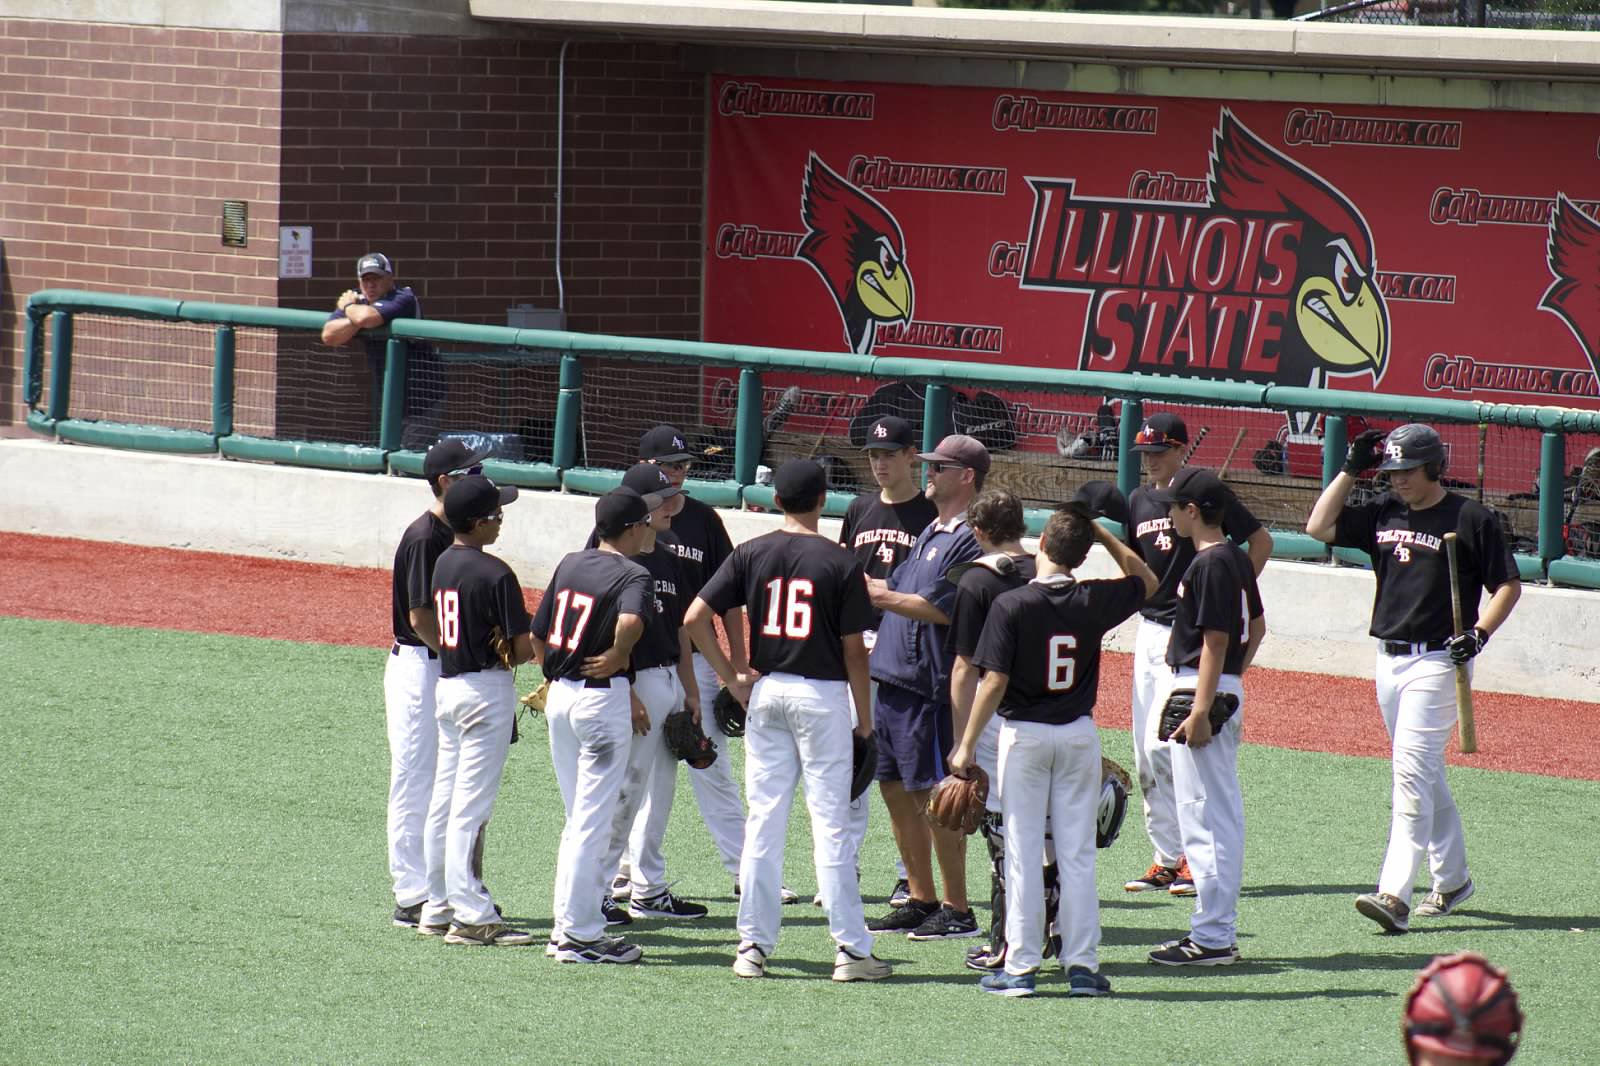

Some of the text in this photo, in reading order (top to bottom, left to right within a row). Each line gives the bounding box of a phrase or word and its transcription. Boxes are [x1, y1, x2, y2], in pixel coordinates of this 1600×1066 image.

[993, 95, 1157, 134] GOREDBIRDS.COM
[1285, 109, 1461, 149] GOREDBIRDS.COM
[1027, 186, 1302, 295] ILLINOIS
[1088, 290, 1289, 373] STATE
[1385, 440, 1403, 460] AB
[678, 545, 704, 563] BARN
[854, 529, 918, 548] ATHLETIC BAR
[876, 542, 893, 564] AB
[1154, 531, 1172, 550] AB
[1393, 542, 1410, 563] AB
[1415, 531, 1442, 551] BARN
[434, 589, 460, 648] 18
[548, 588, 595, 651] 17
[762, 576, 815, 639] 16
[1047, 634, 1078, 691] 6
